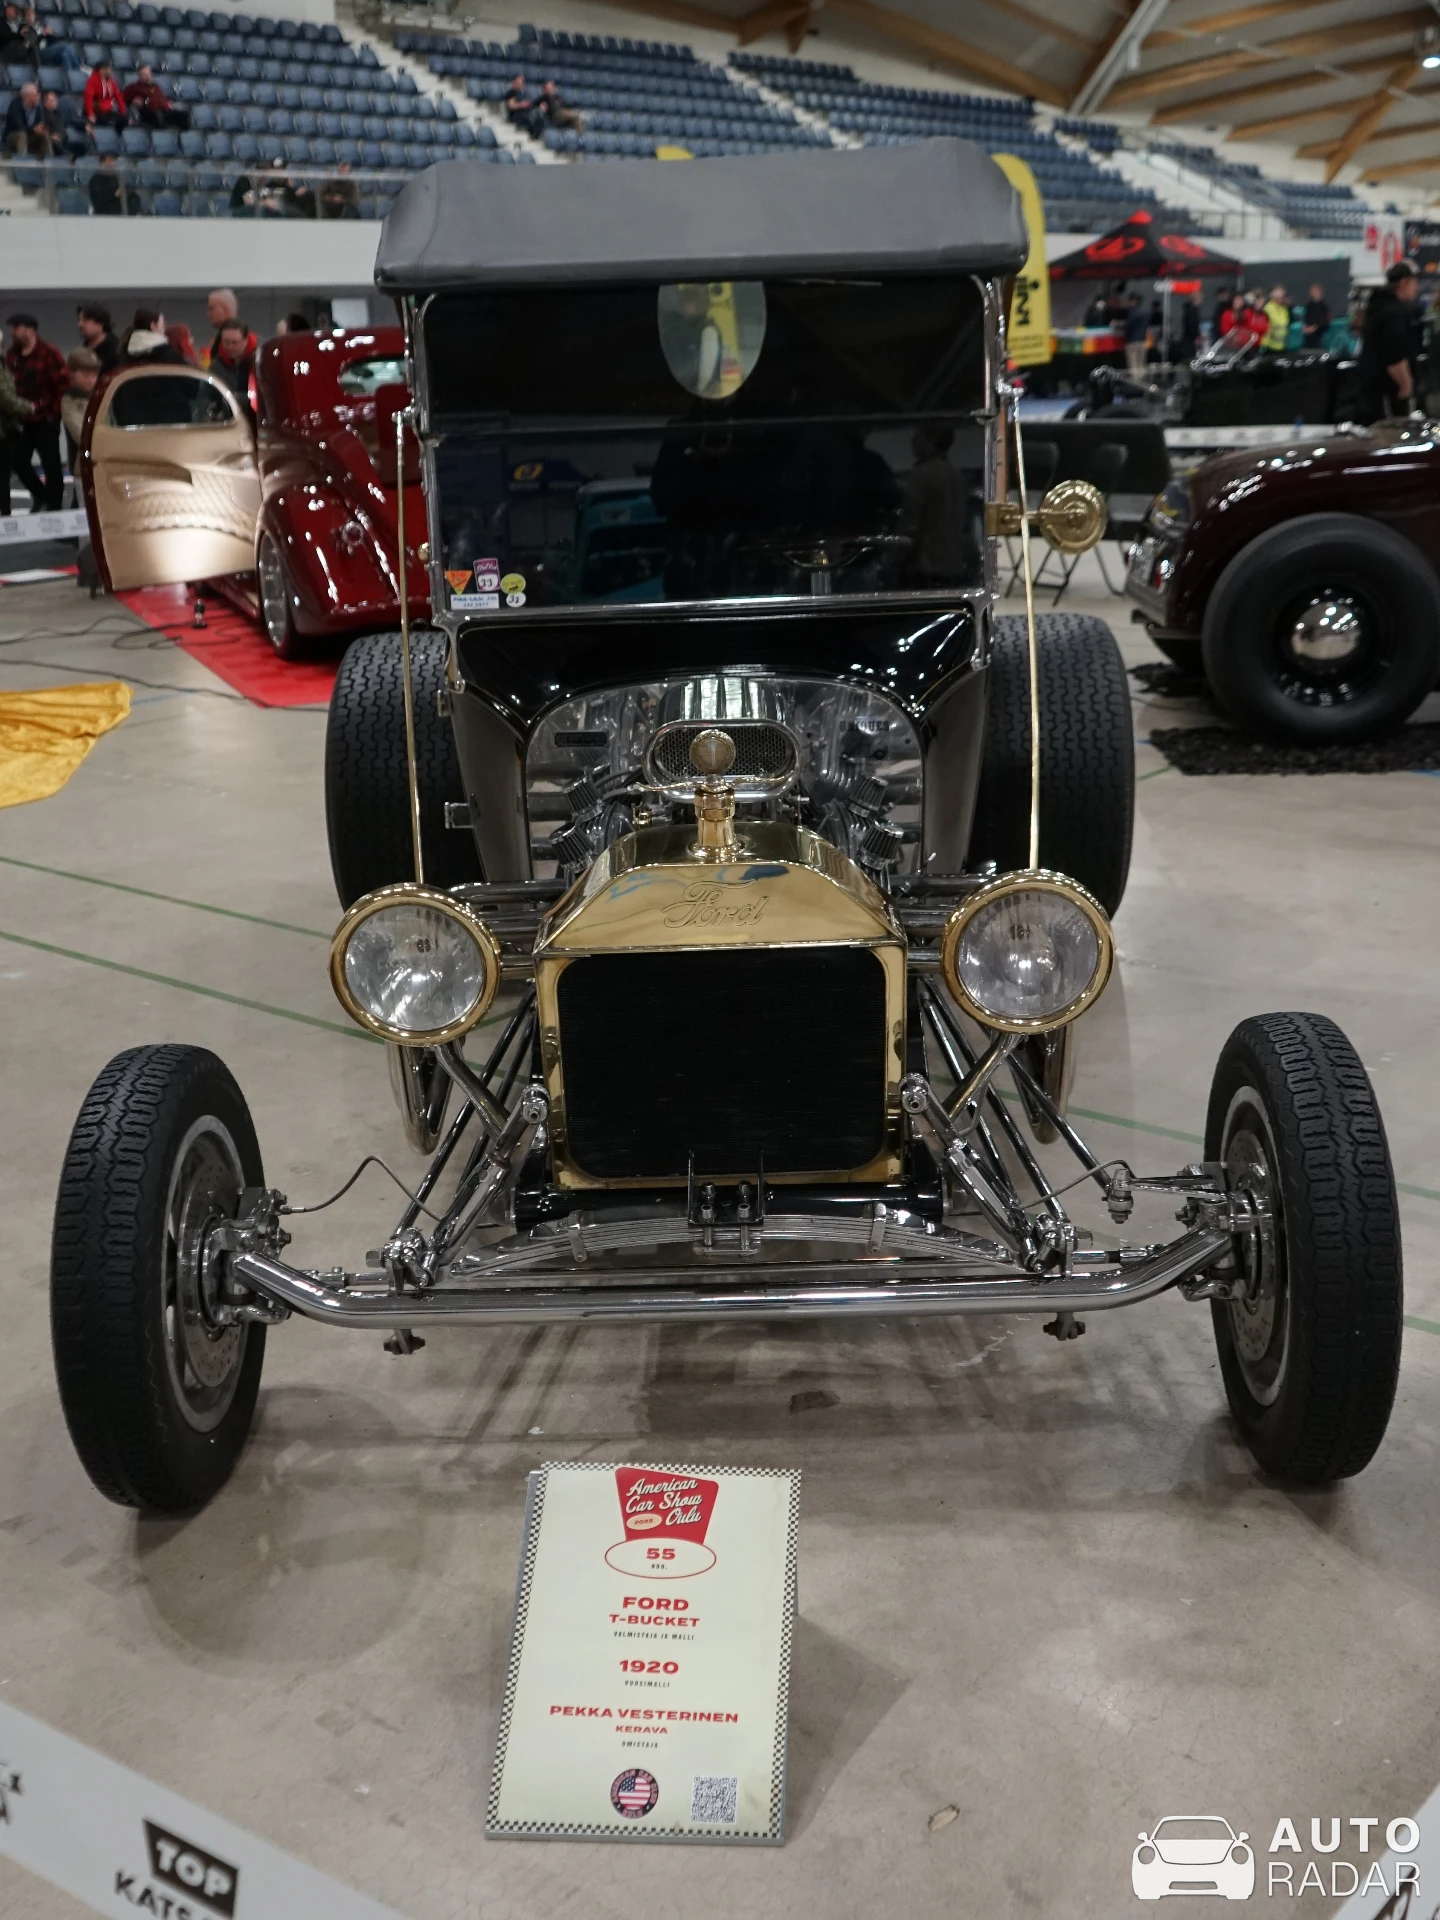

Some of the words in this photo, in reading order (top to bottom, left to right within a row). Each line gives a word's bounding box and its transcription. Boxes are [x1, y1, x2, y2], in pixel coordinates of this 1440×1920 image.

[661, 896, 769, 928] Ford
[626, 1478, 698, 1496] American
[625, 1496, 655, 1513] Car
[659, 1491, 702, 1509] Show
[665, 1505, 702, 1526] Oulu
[646, 1547, 676, 1560] 55
[622, 1596, 689, 1611] FORD
[609, 1614, 700, 1627] T-BUCKET
[613, 1631, 658, 1639] VALMISTAJA
[671, 1633, 694, 1641] MALLI
[619, 1659, 679, 1675] 1920
[624, 1680, 670, 1688] VUOSIMALLI
[550, 1705, 613, 1718] PEKKA
[617, 1708, 739, 1723] VESTERINEN
[615, 1725, 668, 1734] KERAVA
[621, 1741, 658, 1749] OMISTAJA
[155, 1838, 233, 1898] TOP
[112, 1867, 213, 1920] KATS
